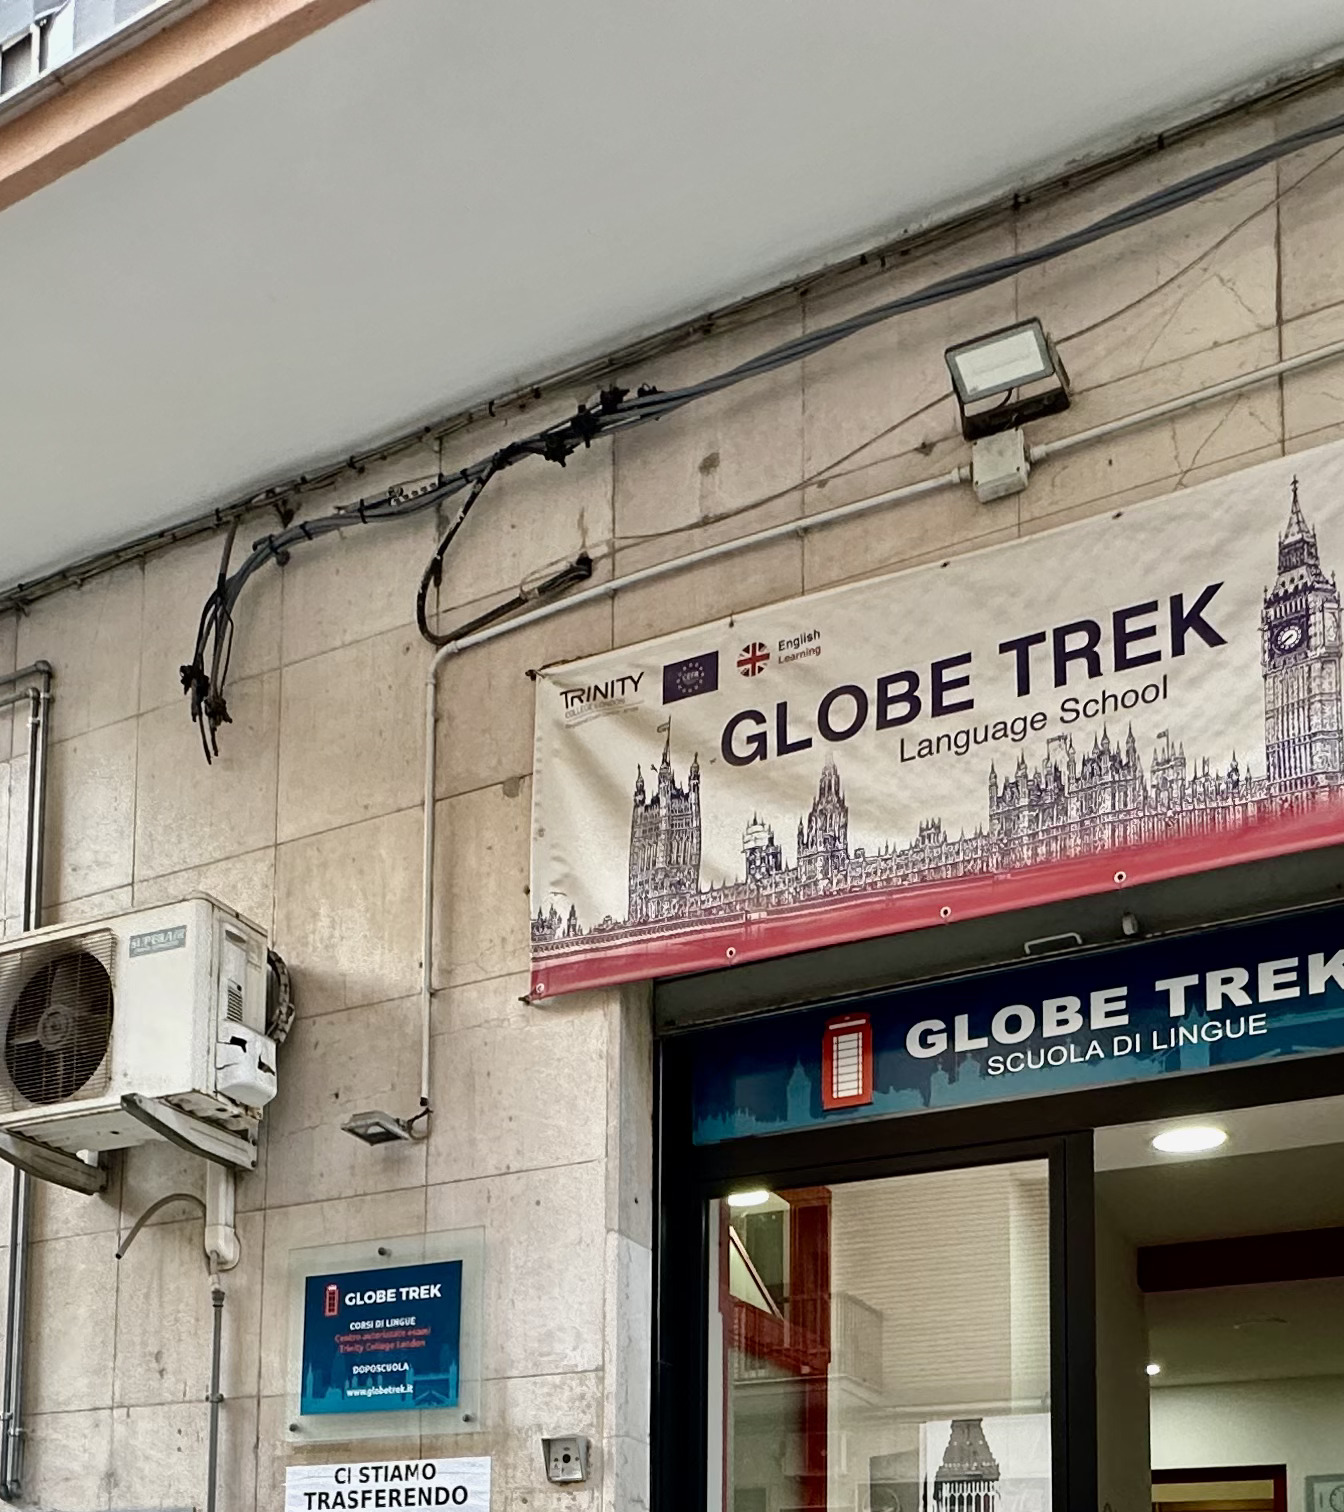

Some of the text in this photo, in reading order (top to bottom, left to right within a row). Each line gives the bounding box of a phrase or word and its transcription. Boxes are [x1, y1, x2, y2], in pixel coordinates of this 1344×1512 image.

[778, 629, 821, 651] English
[778, 645, 821, 665] Learning
[720, 581, 1228, 768] GLOBE TREK
[560, 672, 644, 709] TRINITY
[900, 675, 1168, 762] Language School
[905, 984, 1128, 1060] GLOBE
[986, 1013, 1267, 1076] SCUOLA DI LINGUE
[345, 1284, 441, 1306] GLOBE TREK
[349, 1317, 416, 1330] CORSI DI LINGUE
[339, 1339, 426, 1354] Trinity College London
[353, 1362, 409, 1374] DOPOSCUOLA
[347, 1384, 413, 1397] www.globetrek.it
[334, 1463, 436, 1484] CI STIAMO
[304, 1485, 468, 1511] TRASFERENDO
